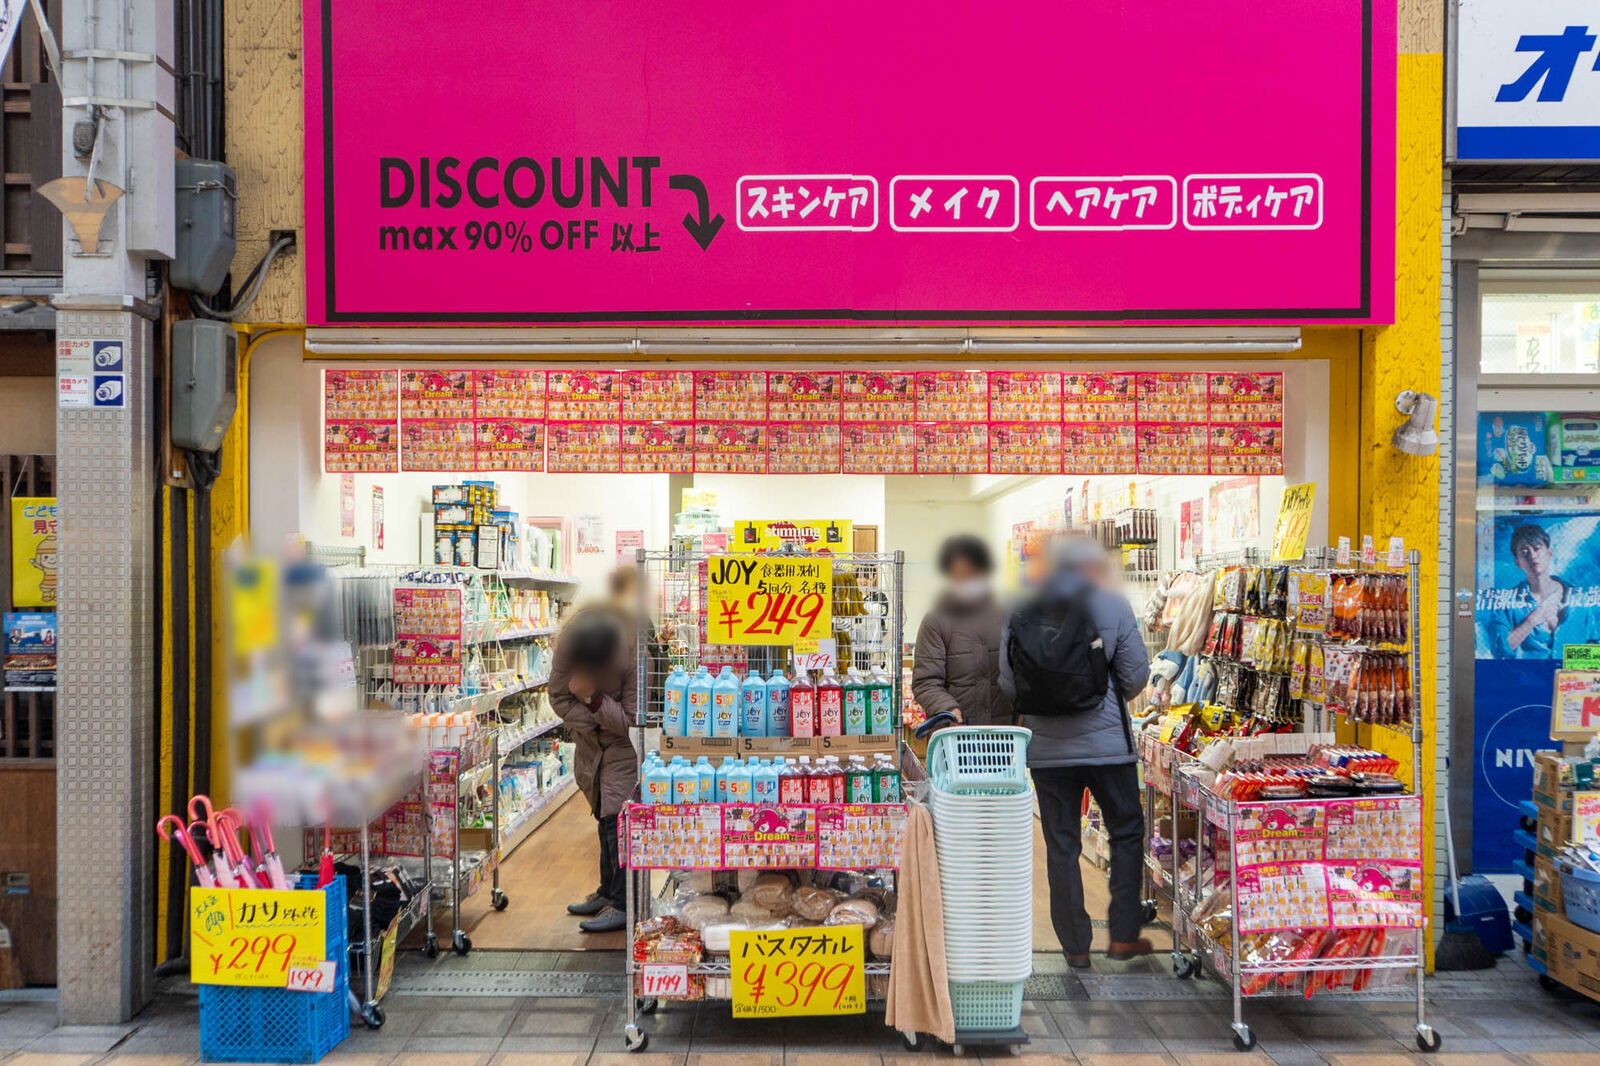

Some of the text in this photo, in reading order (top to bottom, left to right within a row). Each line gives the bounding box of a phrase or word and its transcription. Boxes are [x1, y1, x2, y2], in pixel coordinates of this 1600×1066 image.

[380, 156, 660, 208] DISCOUNT
[747, 184, 868, 219] スキンケア
[909, 187, 1000, 219] メイク
[1046, 185, 1157, 219] ヘアケア
[1193, 184, 1313, 219] ボディケア
[379, 220, 661, 253] max 90% OFF 以上
[712, 559, 758, 585] JOY
[742, 934, 854, 958] バスタオル
